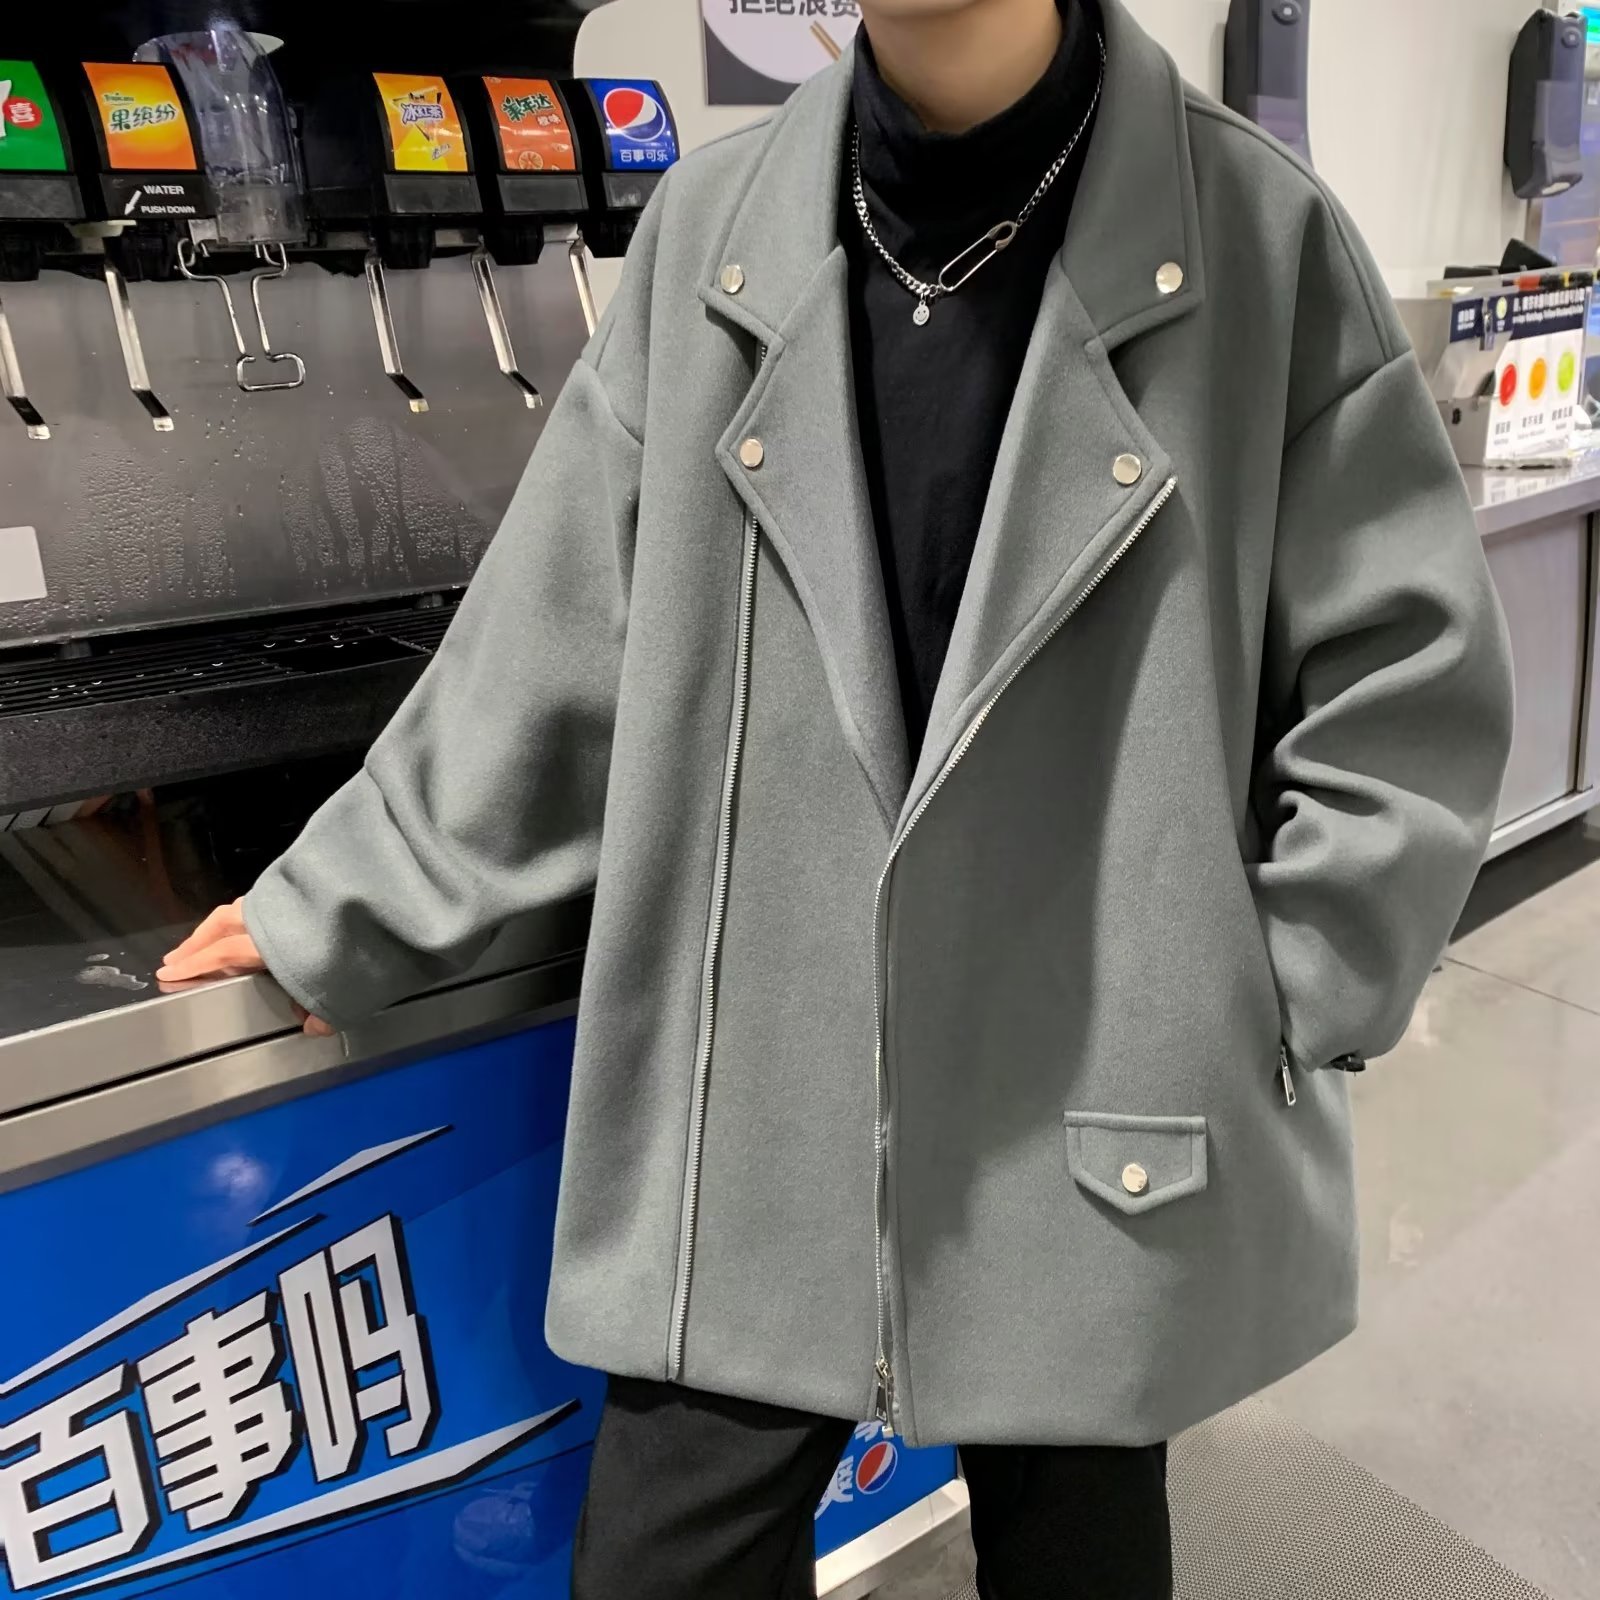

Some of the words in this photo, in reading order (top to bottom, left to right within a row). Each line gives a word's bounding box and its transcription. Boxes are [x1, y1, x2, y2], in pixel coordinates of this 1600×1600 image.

[110, 103, 176, 131] 果缤纷
[620, 149, 669, 162] 百事可乐
[143, 185, 185, 195] WATER
[141, 205, 166, 214] PUSH
[167, 205, 196, 214] DOWN
